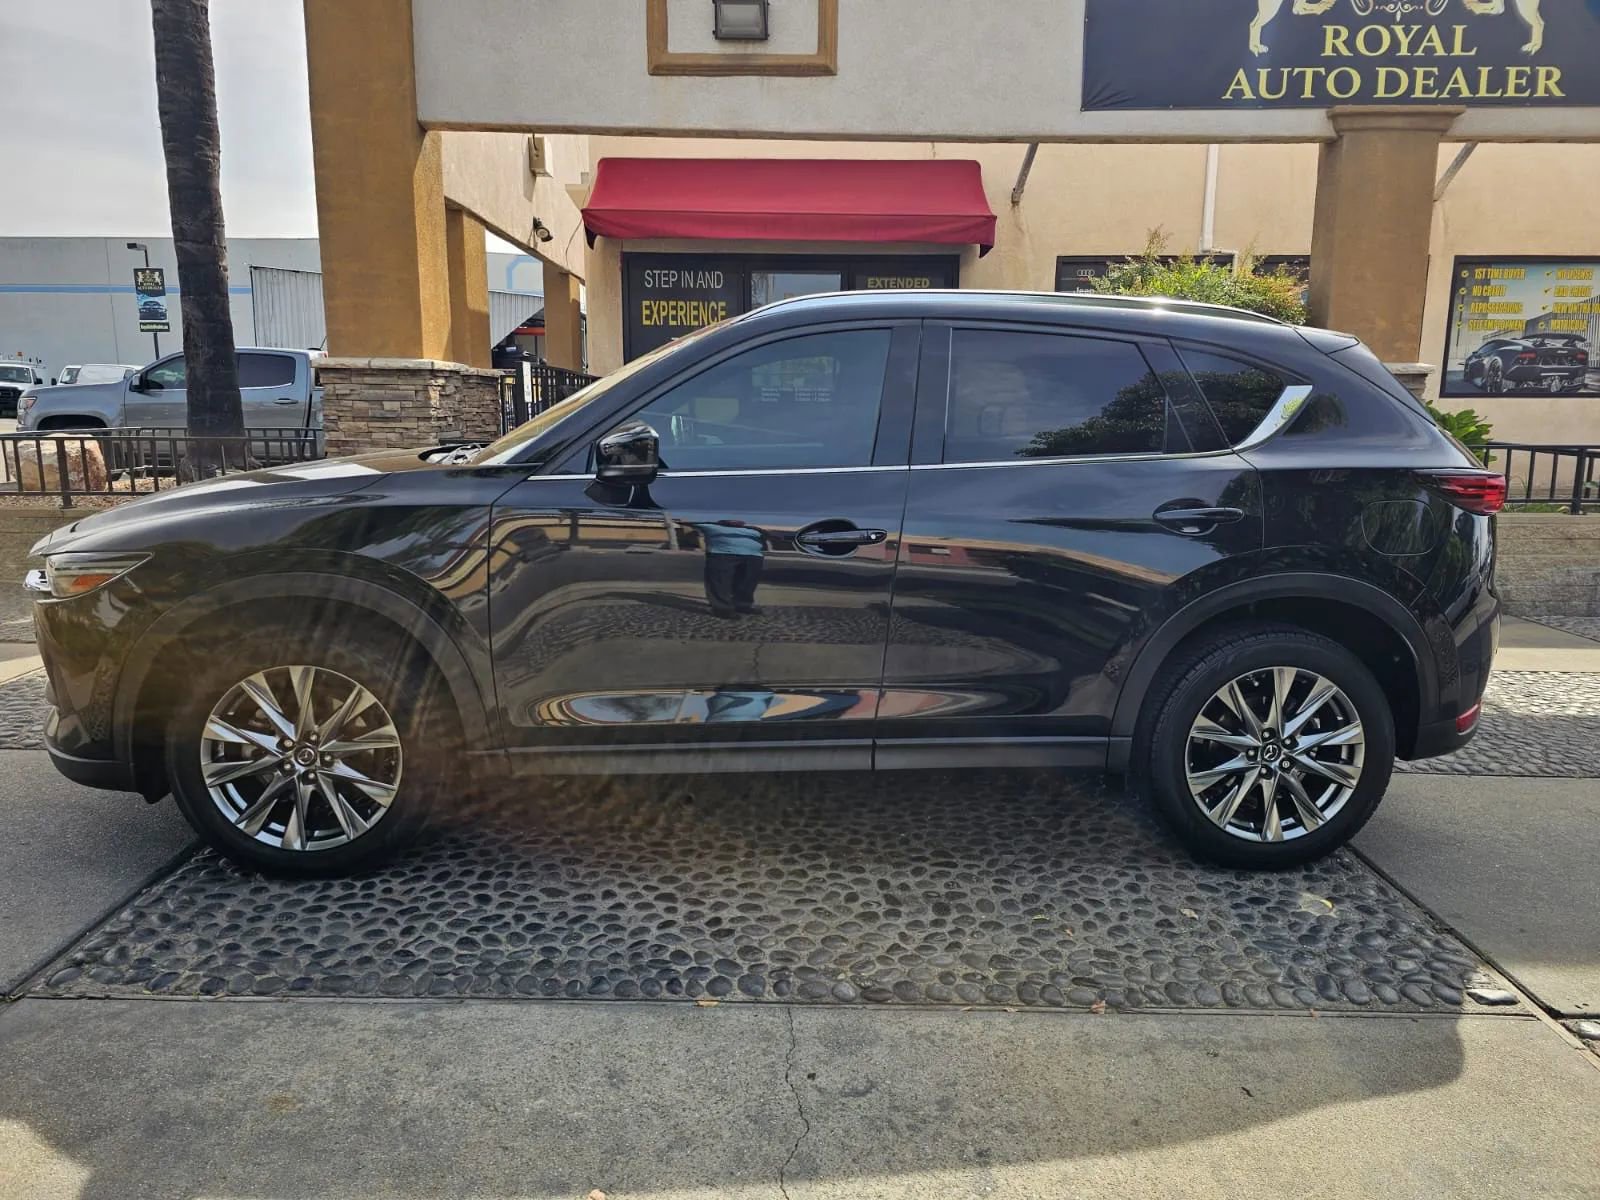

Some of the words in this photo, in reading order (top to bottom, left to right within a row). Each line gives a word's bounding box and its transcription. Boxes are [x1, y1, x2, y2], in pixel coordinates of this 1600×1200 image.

[1320, 24, 1477, 57] ROYAL
[1221, 66, 1361, 100] AUTO
[1372, 65, 1566, 99] DEALER
[644, 270, 678, 288] STEP
[681, 271, 694, 288] IN
[696, 271, 724, 289] AND
[867, 277, 930, 289] EXTENDED
[642, 300, 727, 326] EXPERIENCE
